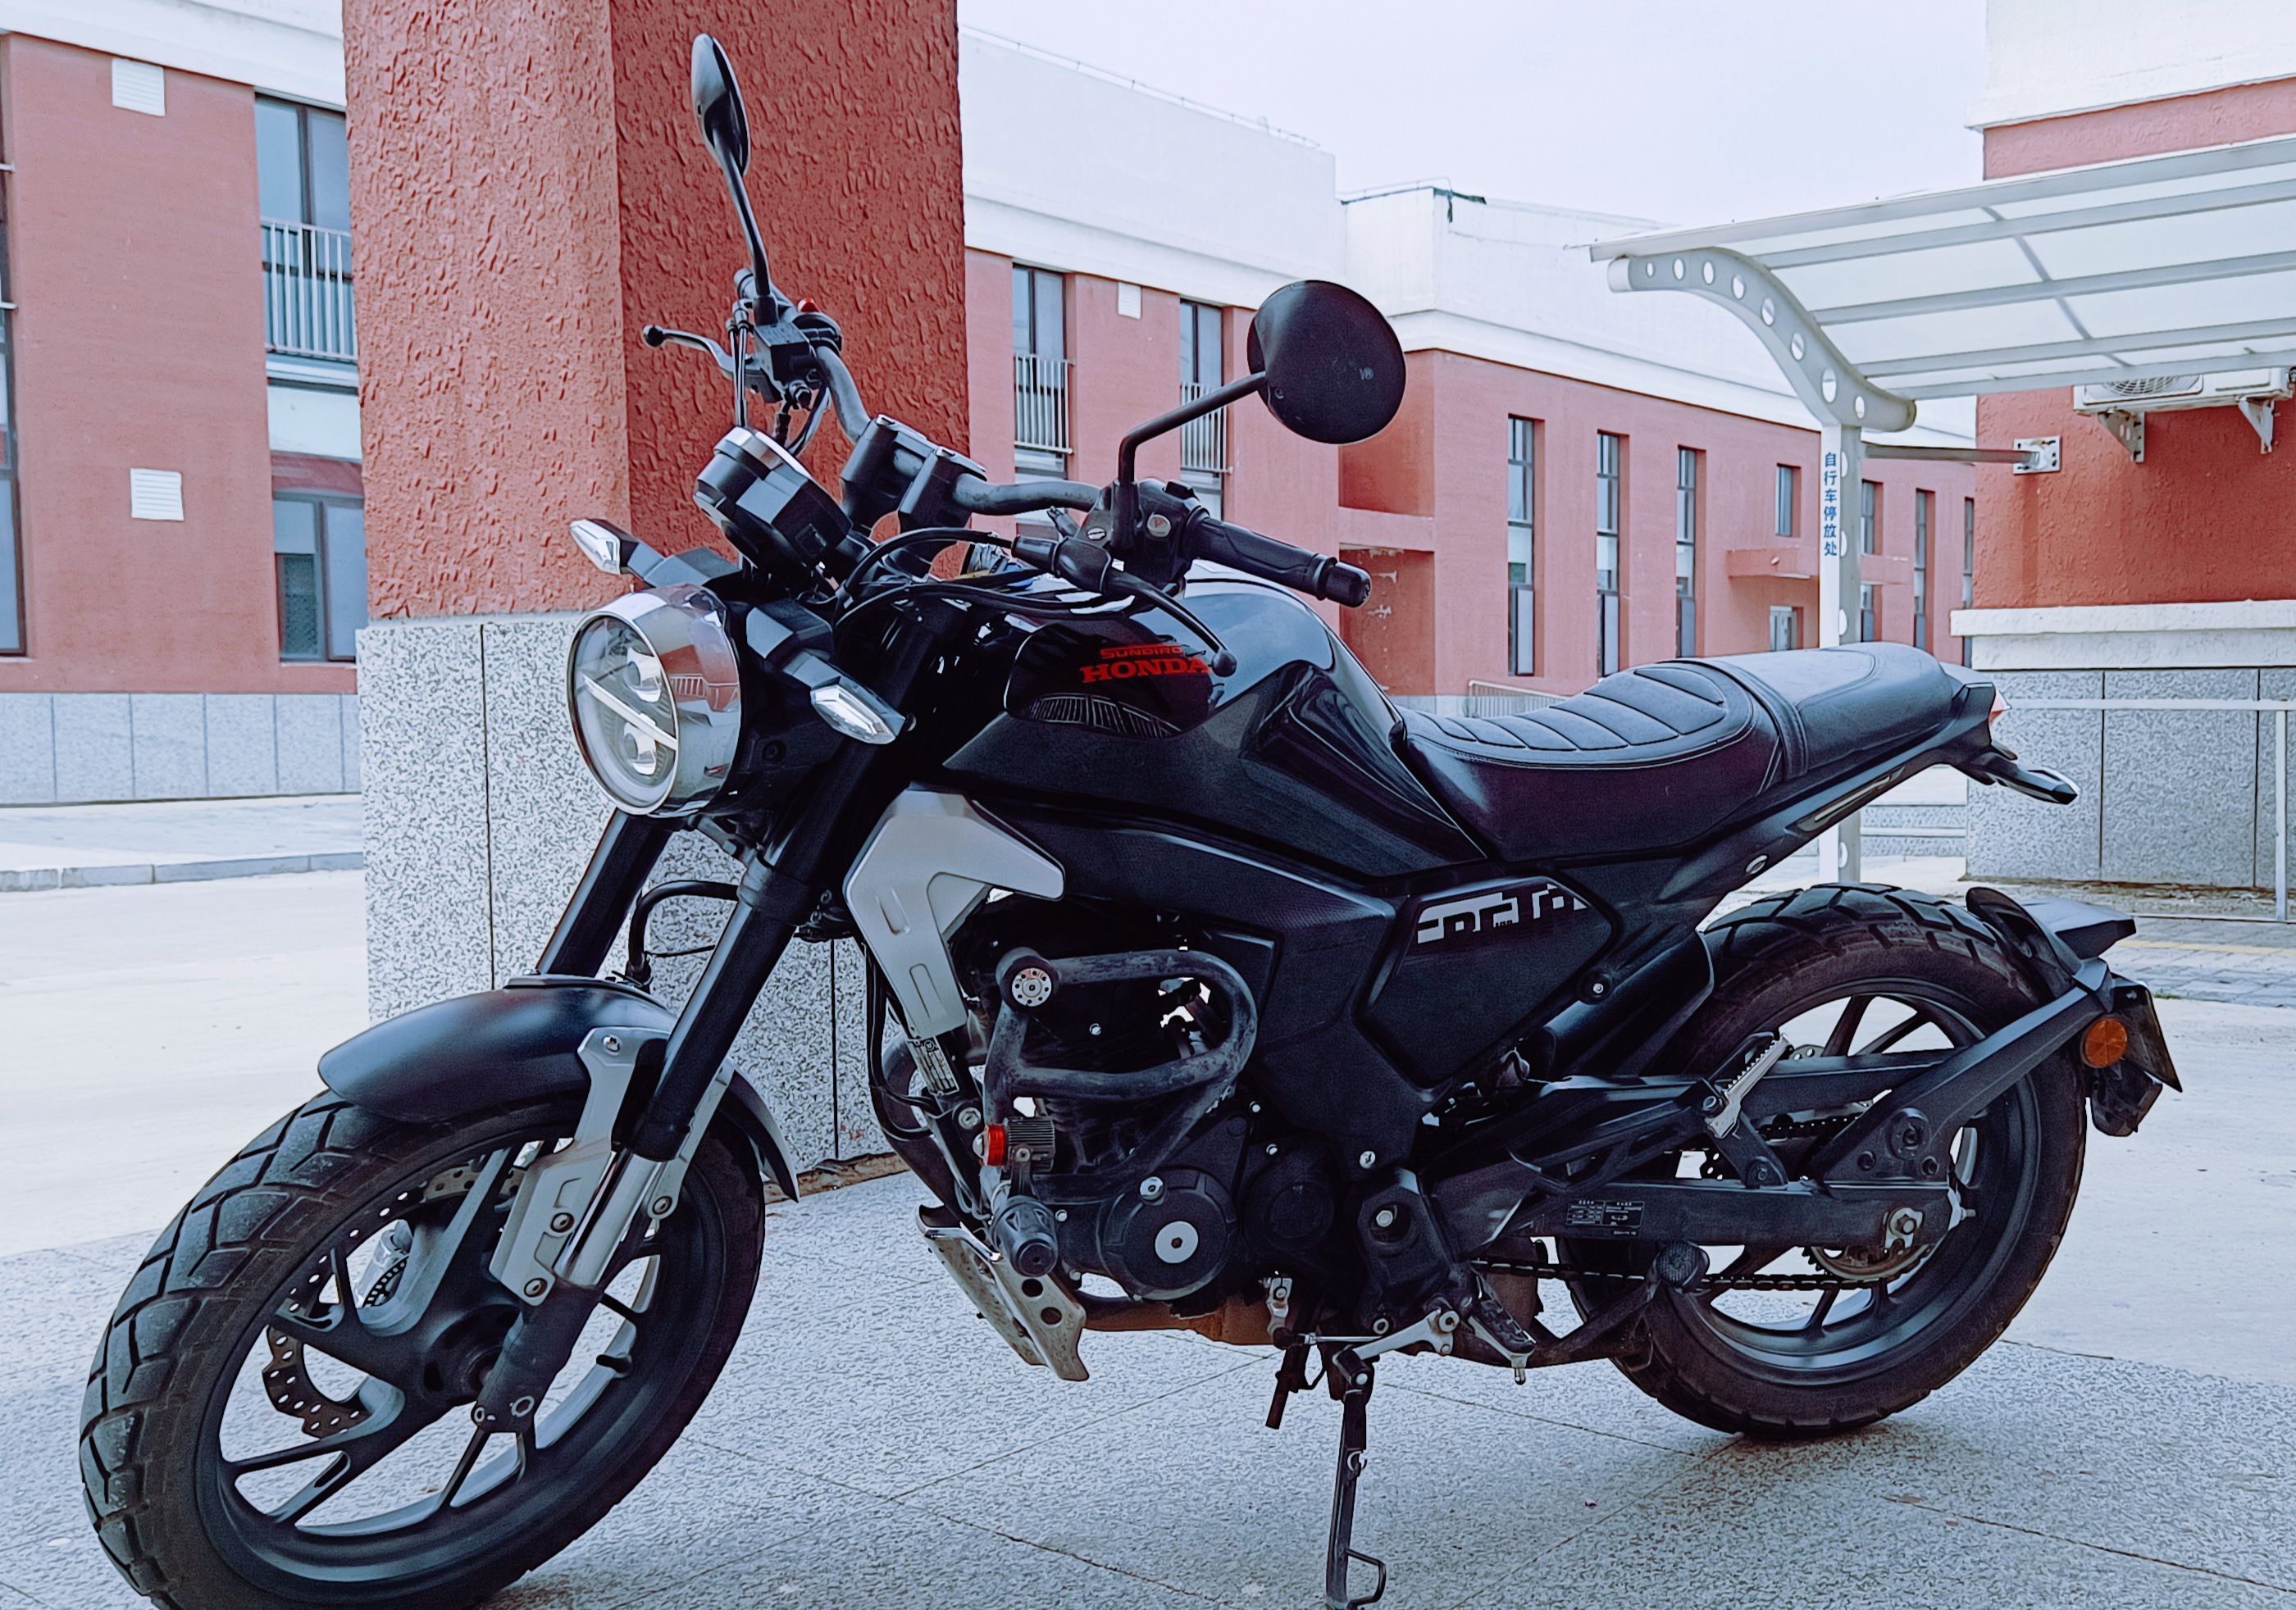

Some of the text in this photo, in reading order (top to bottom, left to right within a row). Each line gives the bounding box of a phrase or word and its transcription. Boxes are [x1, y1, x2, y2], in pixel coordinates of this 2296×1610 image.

[1824, 453, 1837, 556] 自行车停放处
[1100, 644, 1182, 659] SUNDIRO
[1080, 657, 1211, 683] HONDA
